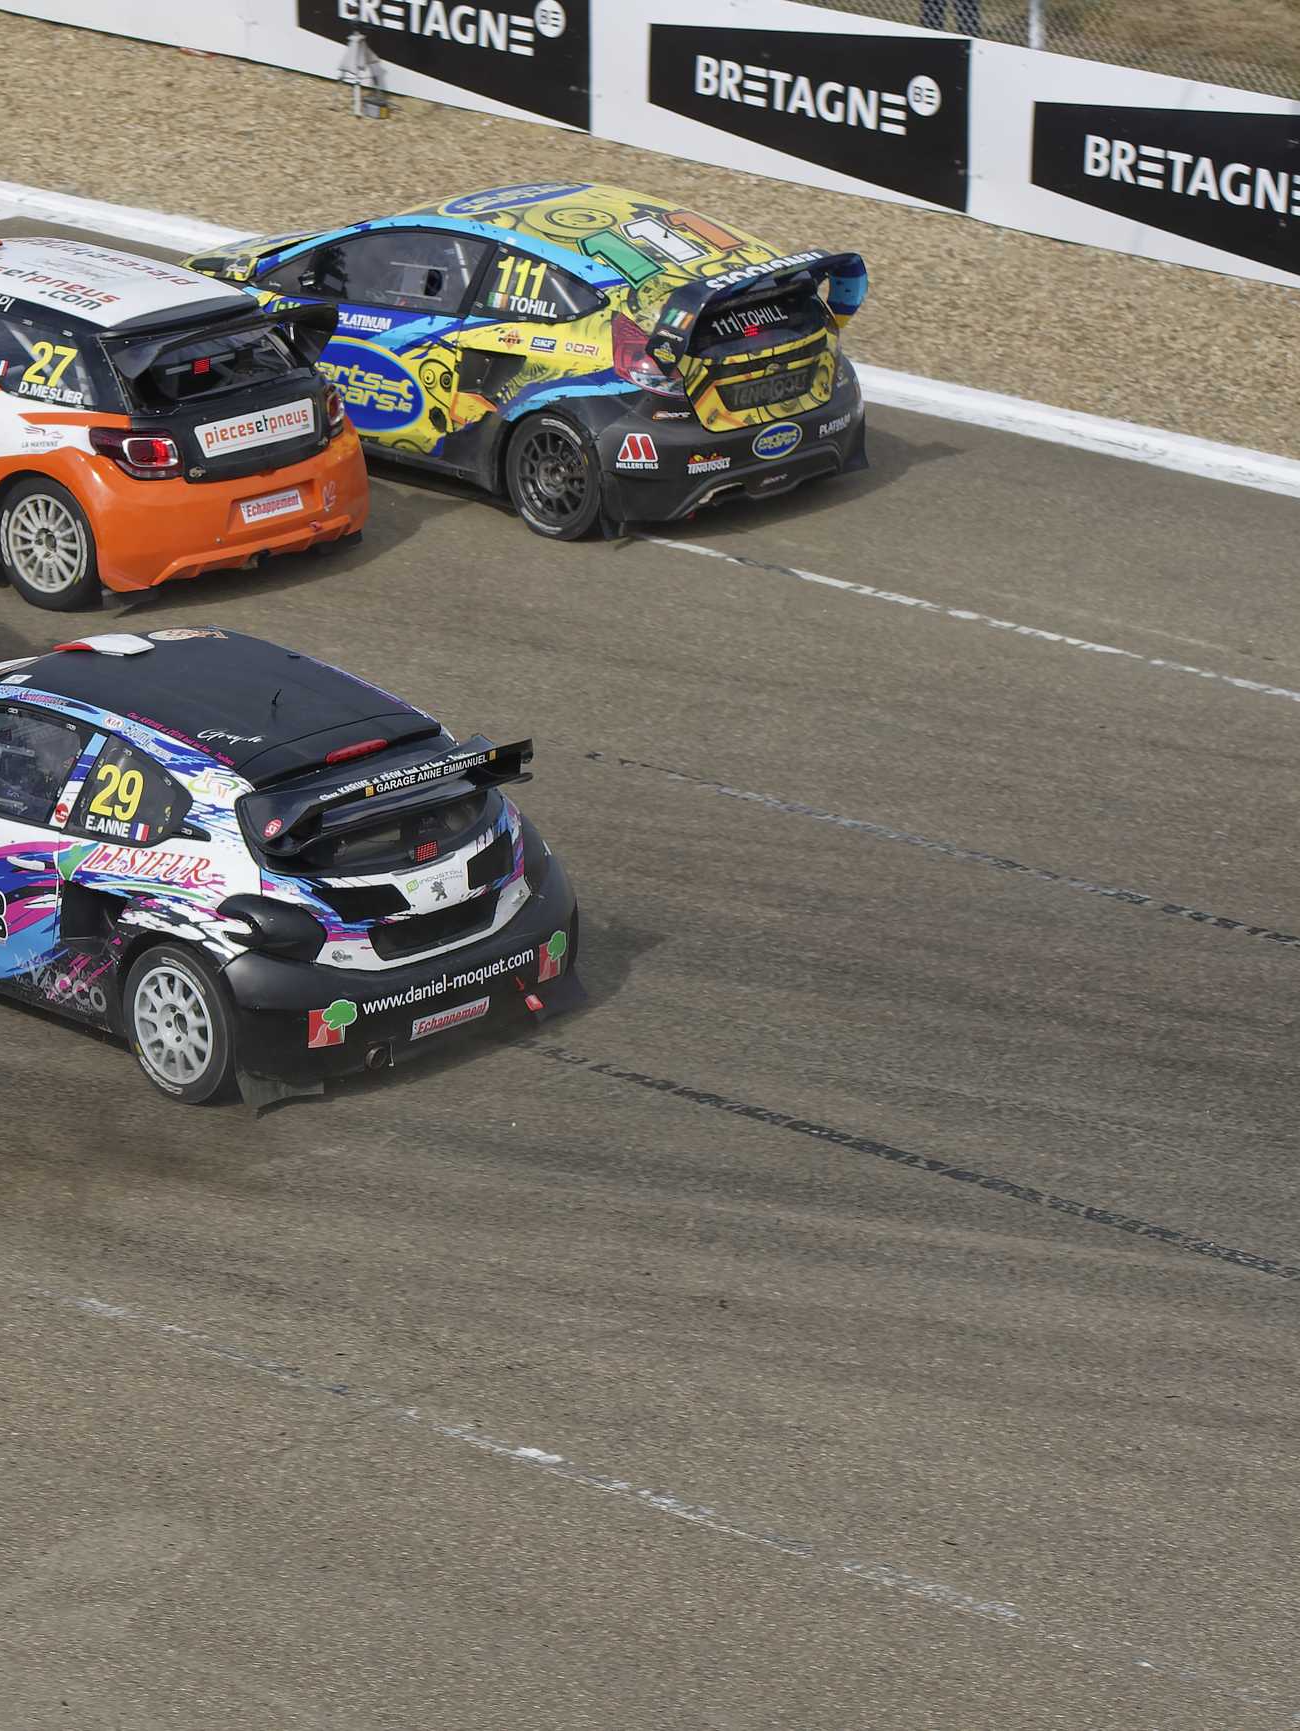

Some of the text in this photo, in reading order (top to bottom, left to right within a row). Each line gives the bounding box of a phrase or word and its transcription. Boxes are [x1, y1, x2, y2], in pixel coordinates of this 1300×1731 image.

[694, 54, 867, 136] BRETAGNE
[498, 255, 548, 299] 111
[508, 295, 558, 319] TOHILL
[22, 341, 78, 388] 27
[18, 380, 84, 405] D.MESLIER
[204, 408, 309, 448] piecesetpneus
[89, 764, 144, 821] 29
[376, 776, 416, 793] GARAGE
[417, 767, 442, 783] ANNE
[443, 755, 488, 774] EMMANUEL
[85, 814, 132, 838] E.ANNE
[85, 844, 212, 884] LESIEUR
[362, 948, 534, 1016] www.daniel-moquet.com
